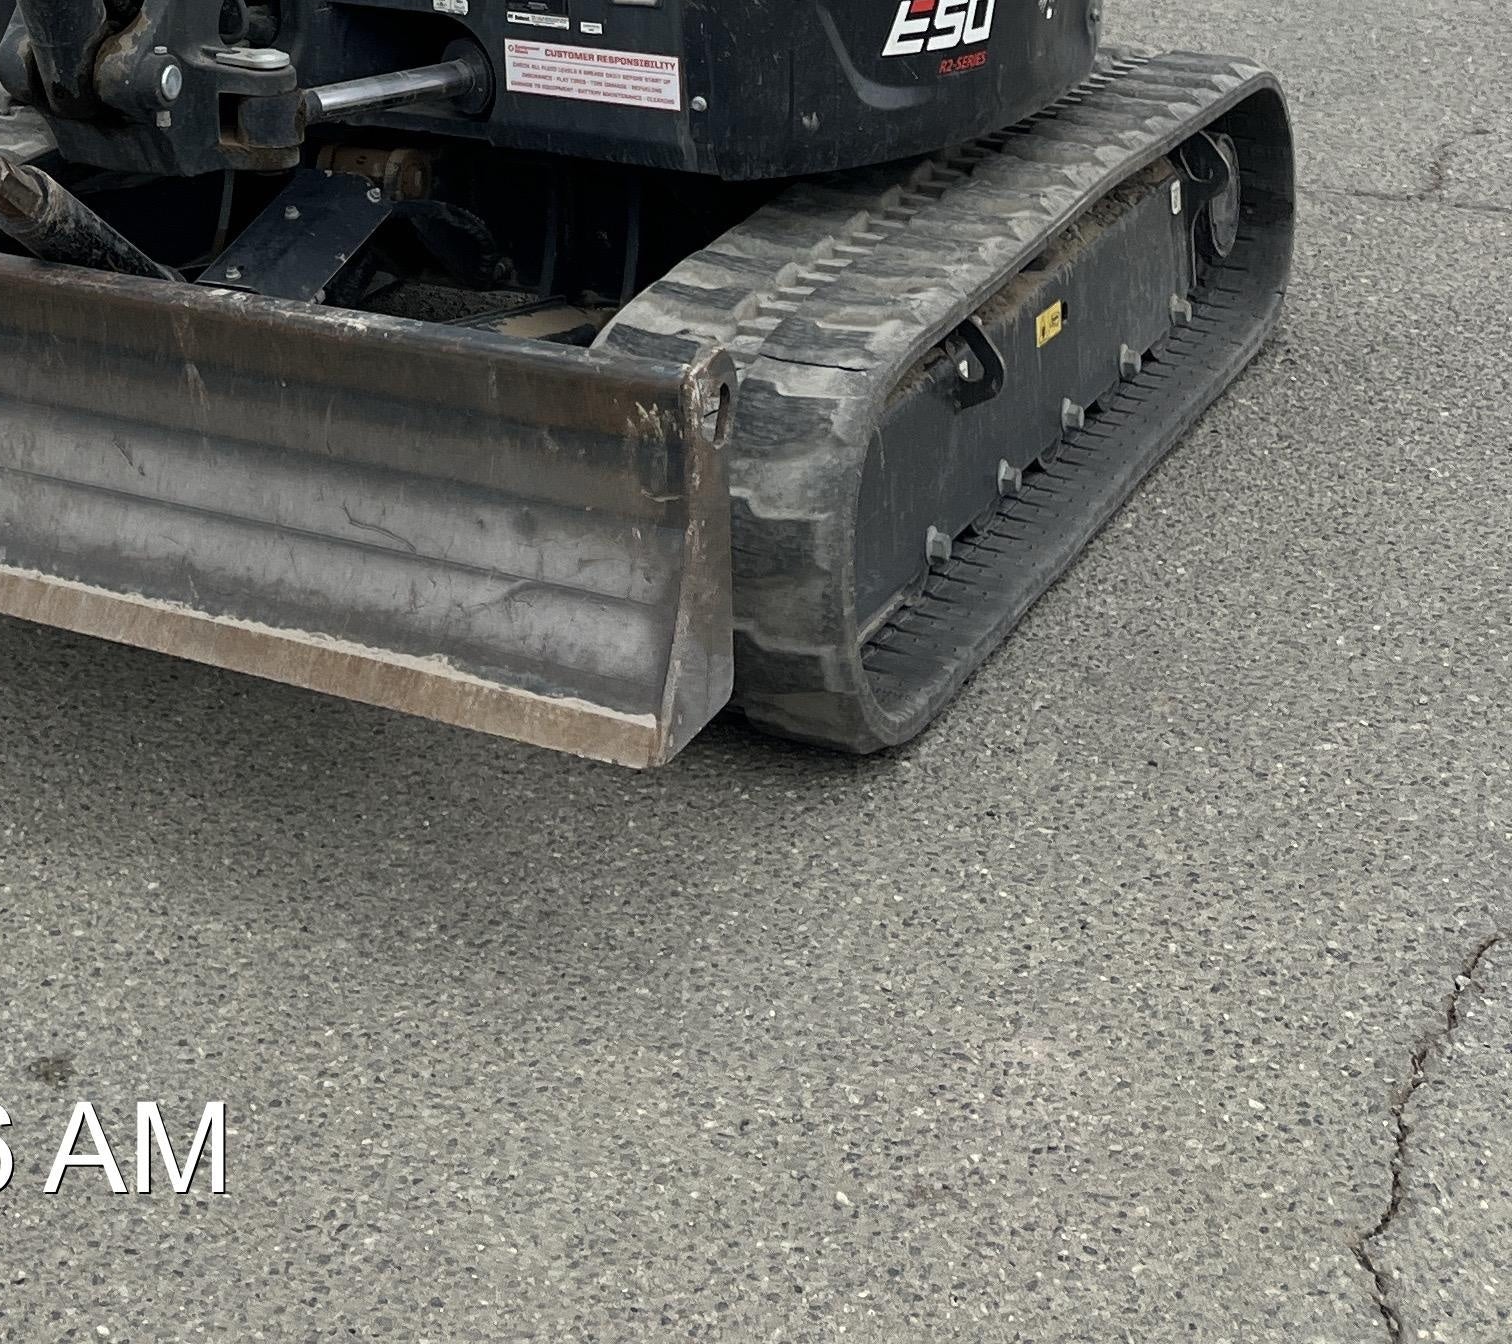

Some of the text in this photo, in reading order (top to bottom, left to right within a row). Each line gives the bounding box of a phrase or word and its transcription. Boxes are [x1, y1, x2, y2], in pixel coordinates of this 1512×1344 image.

[545, 49, 594, 61] CUSTOMER
[597, 54, 676, 70] RESPONSIBILITY
[939, 51, 987, 74] R2-SERIES
